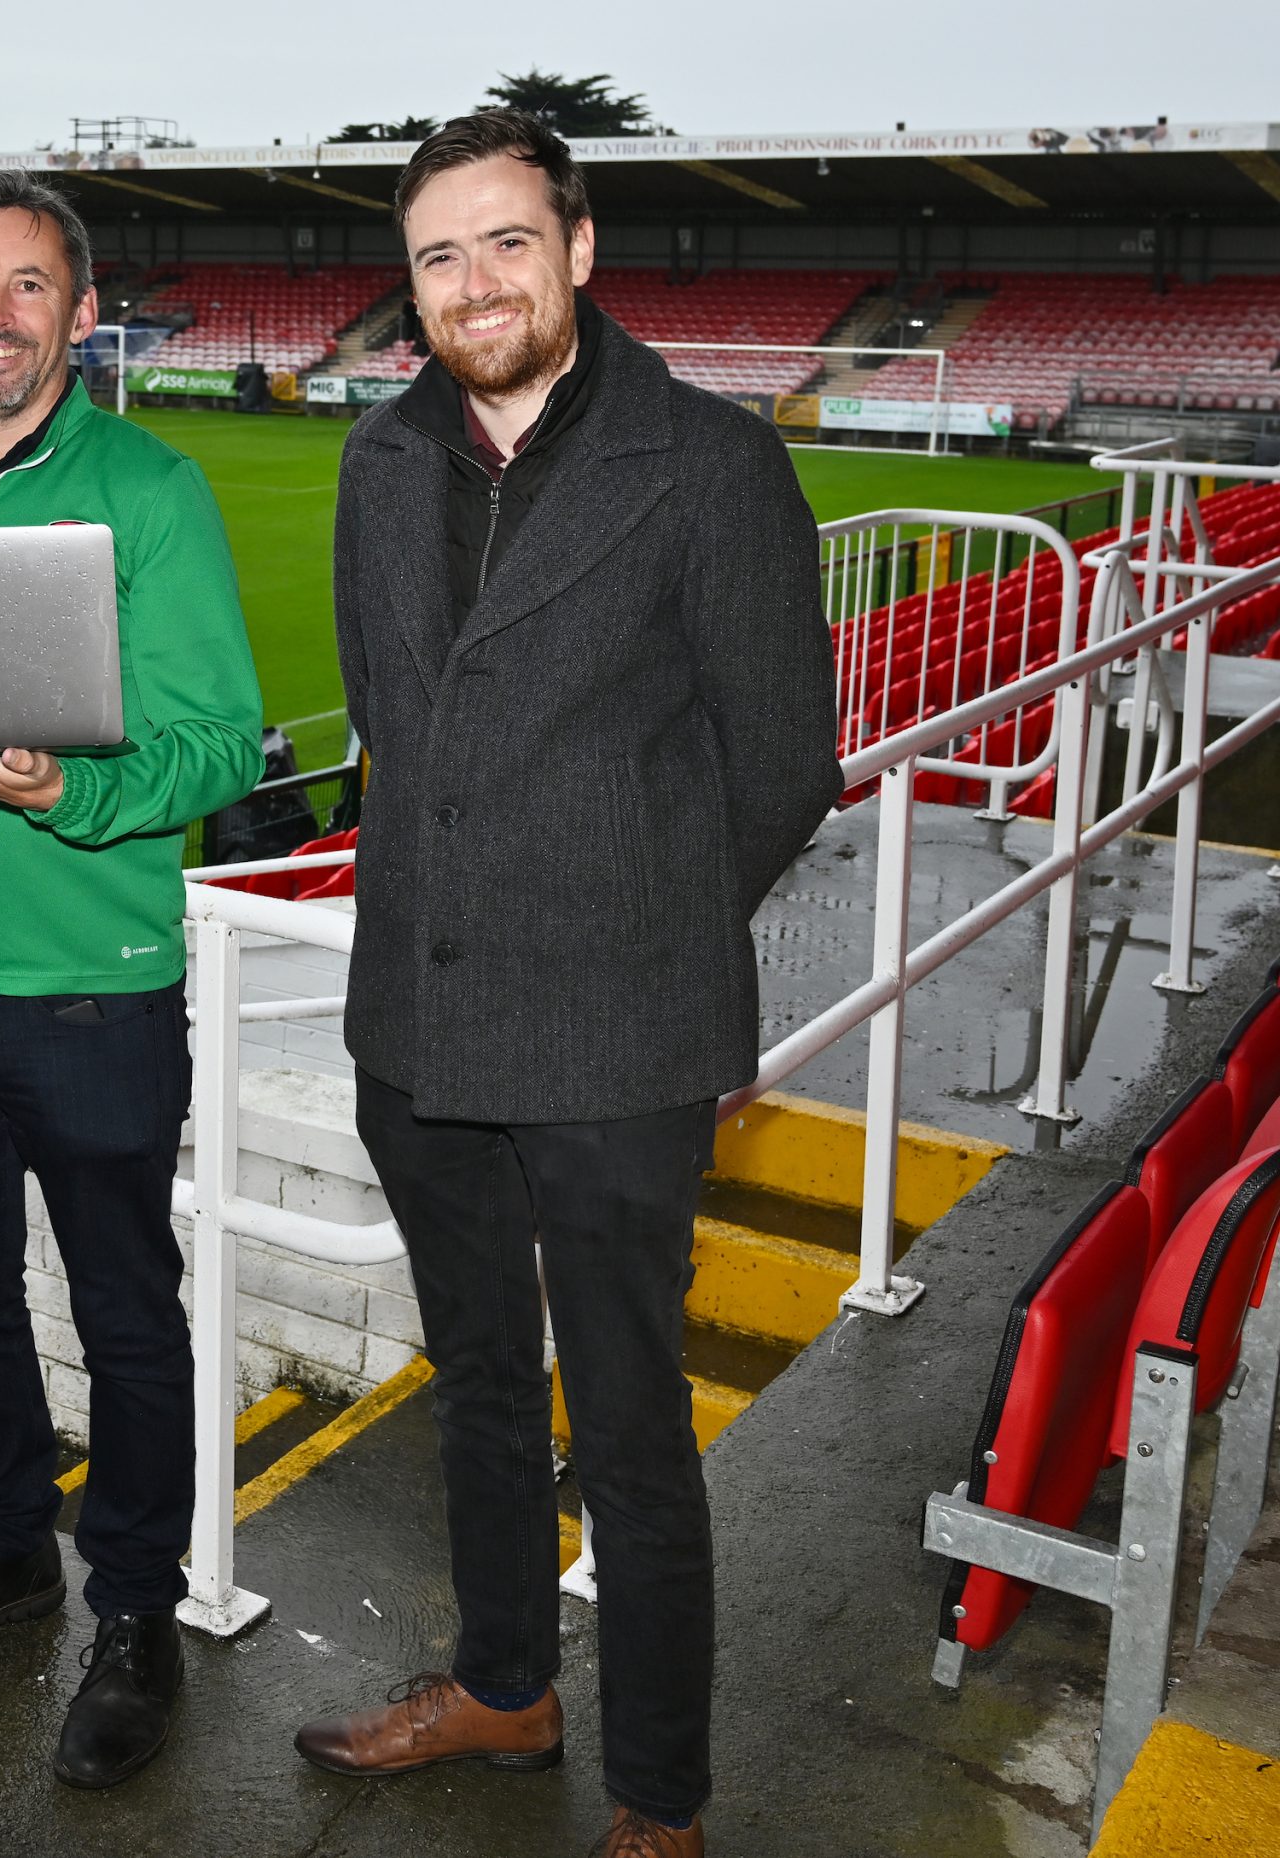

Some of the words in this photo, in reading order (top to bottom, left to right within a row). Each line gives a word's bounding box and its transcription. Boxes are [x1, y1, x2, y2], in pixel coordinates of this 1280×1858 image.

[716, 140, 770, 152] PROUD
[775, 138, 858, 151] SPONSORS
[864, 137, 883, 150] OF
[889, 136, 937, 150] CORK
[941, 134, 979, 148] CITY
[986, 134, 1008, 147] FC
[161, 374, 187, 388] sse
[187, 377, 233, 394] Airtricity
[310, 382, 335, 394] MIG
